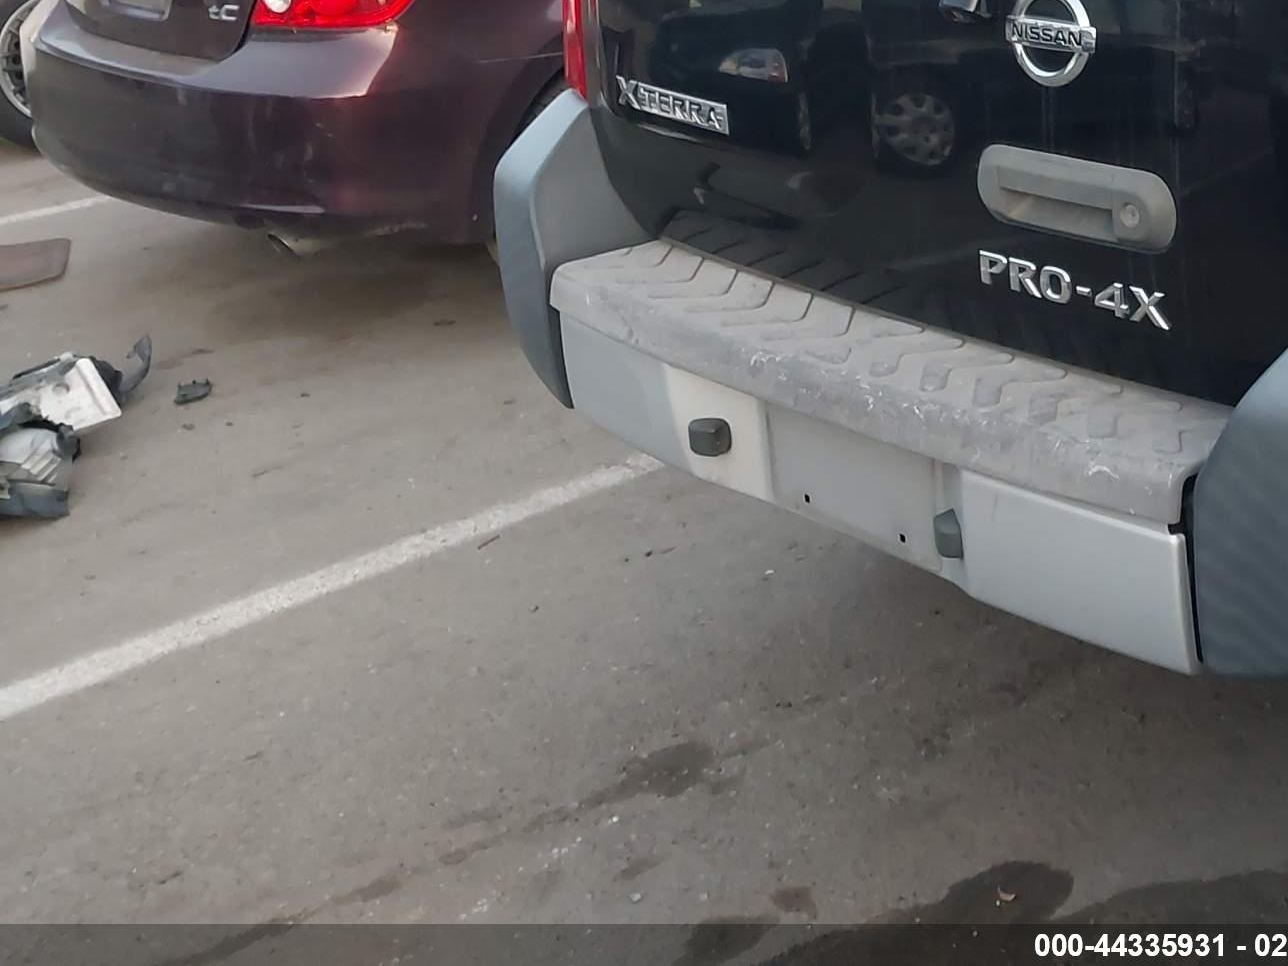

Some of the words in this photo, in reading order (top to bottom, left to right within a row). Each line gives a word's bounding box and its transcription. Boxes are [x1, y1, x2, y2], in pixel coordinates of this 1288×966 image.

[1012, 22, 1082, 47] NISSAN
[616, 75, 729, 135] XTERRA
[979, 250, 1170, 331] PRO-4X
